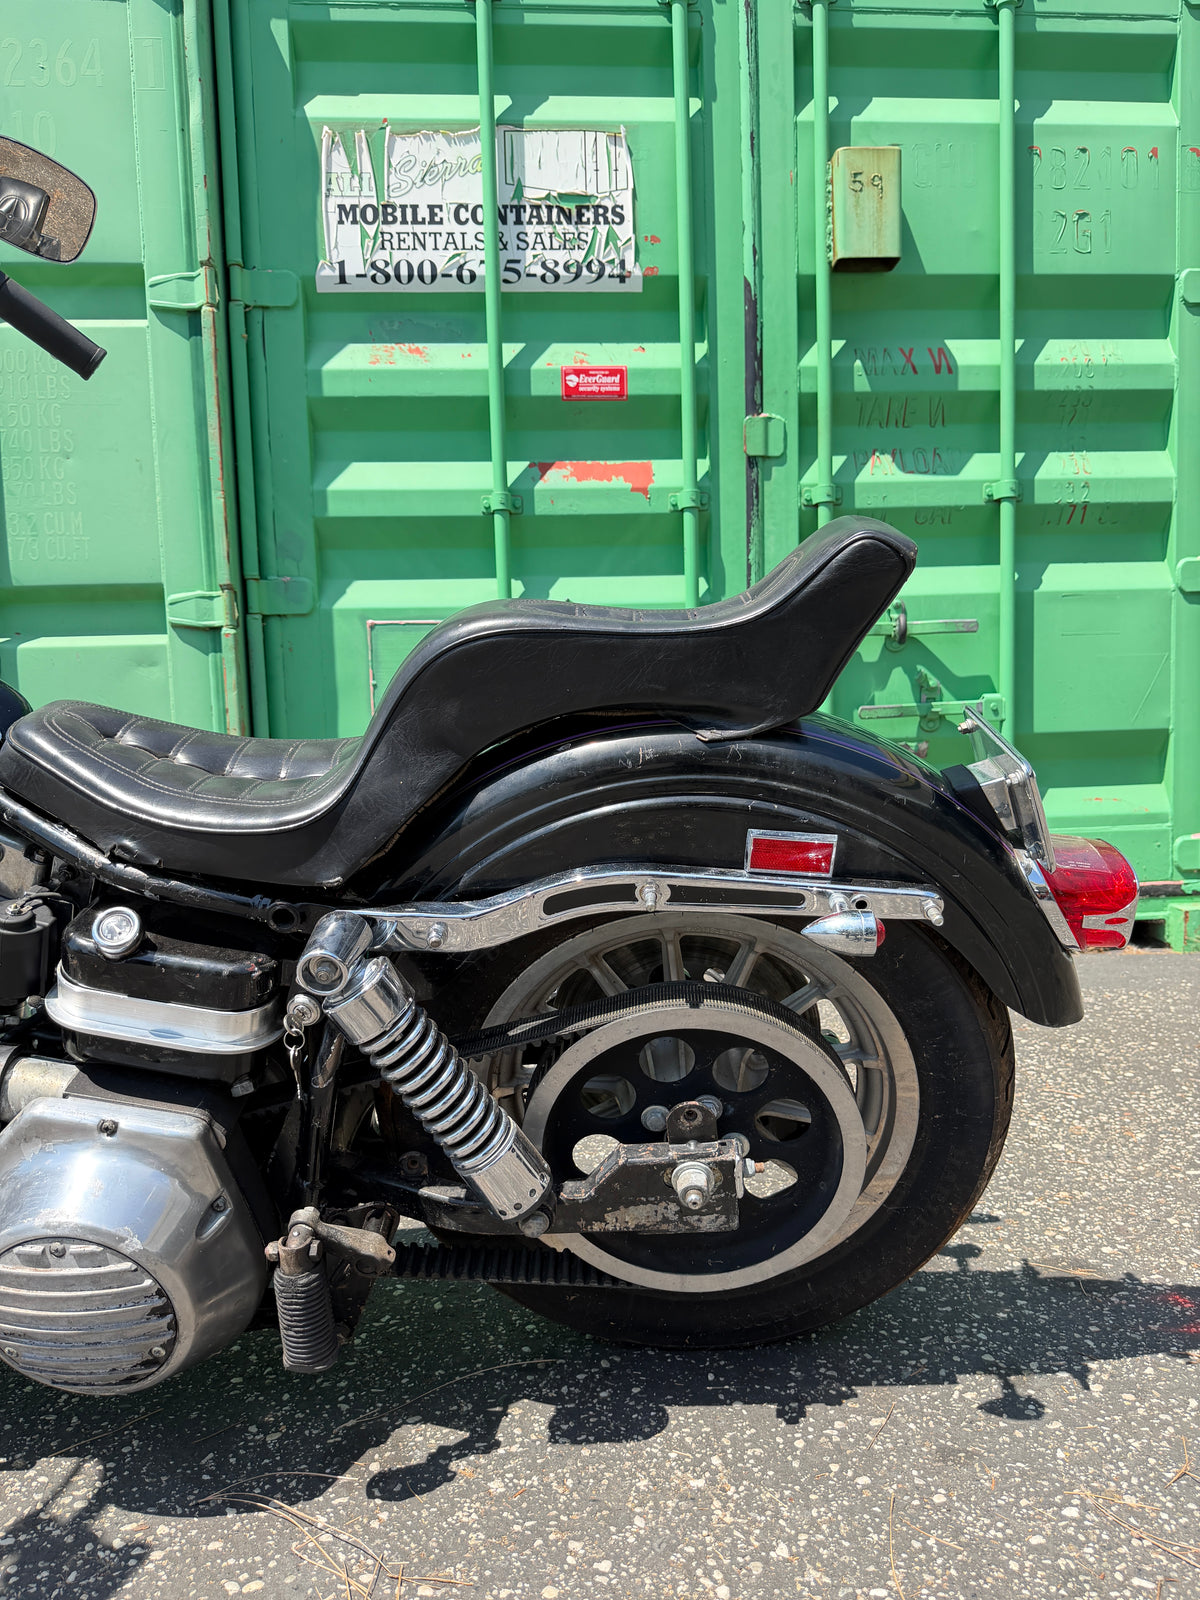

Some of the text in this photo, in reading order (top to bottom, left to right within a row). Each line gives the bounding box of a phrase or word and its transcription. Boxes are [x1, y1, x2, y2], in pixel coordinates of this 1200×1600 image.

[337, 204, 625, 225] MOBILE CONTAINERS
[380, 231, 485, 250] RENTALS
[516, 231, 589, 250] SALES
[334, 258, 626, 285] 1-800-65-8994
[854, 348, 918, 375] MAX
[35, 375, 71, 400] LBS
[37, 402, 62, 428] KG
[39, 429, 74, 453] LBS
[40, 456, 64, 480] KG
